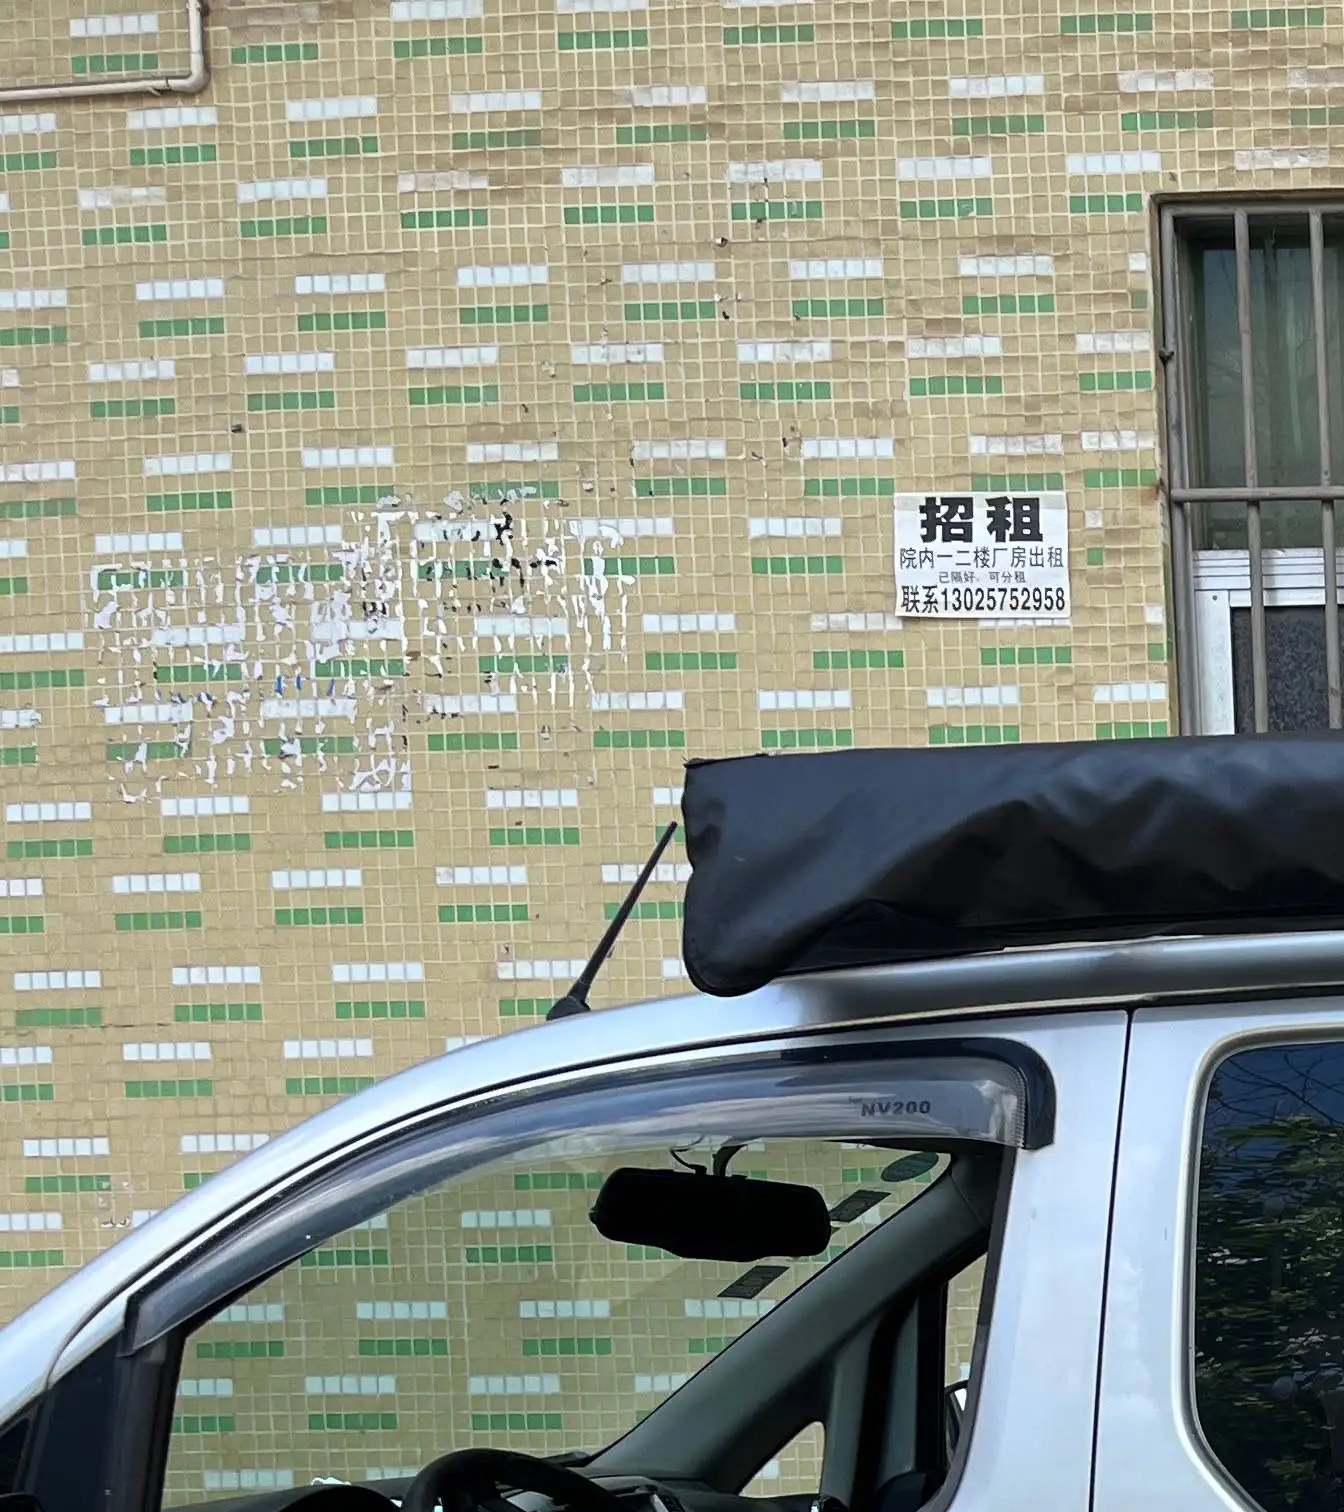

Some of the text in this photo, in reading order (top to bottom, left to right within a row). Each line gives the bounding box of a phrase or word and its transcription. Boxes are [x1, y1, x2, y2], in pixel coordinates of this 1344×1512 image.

[919, 496, 1043, 543] 招租
[899, 546, 1064, 570] 院内一二楼厂房出租
[901, 585, 1065, 614] 联系13025752958
[861, 1101, 931, 1117] NV200
